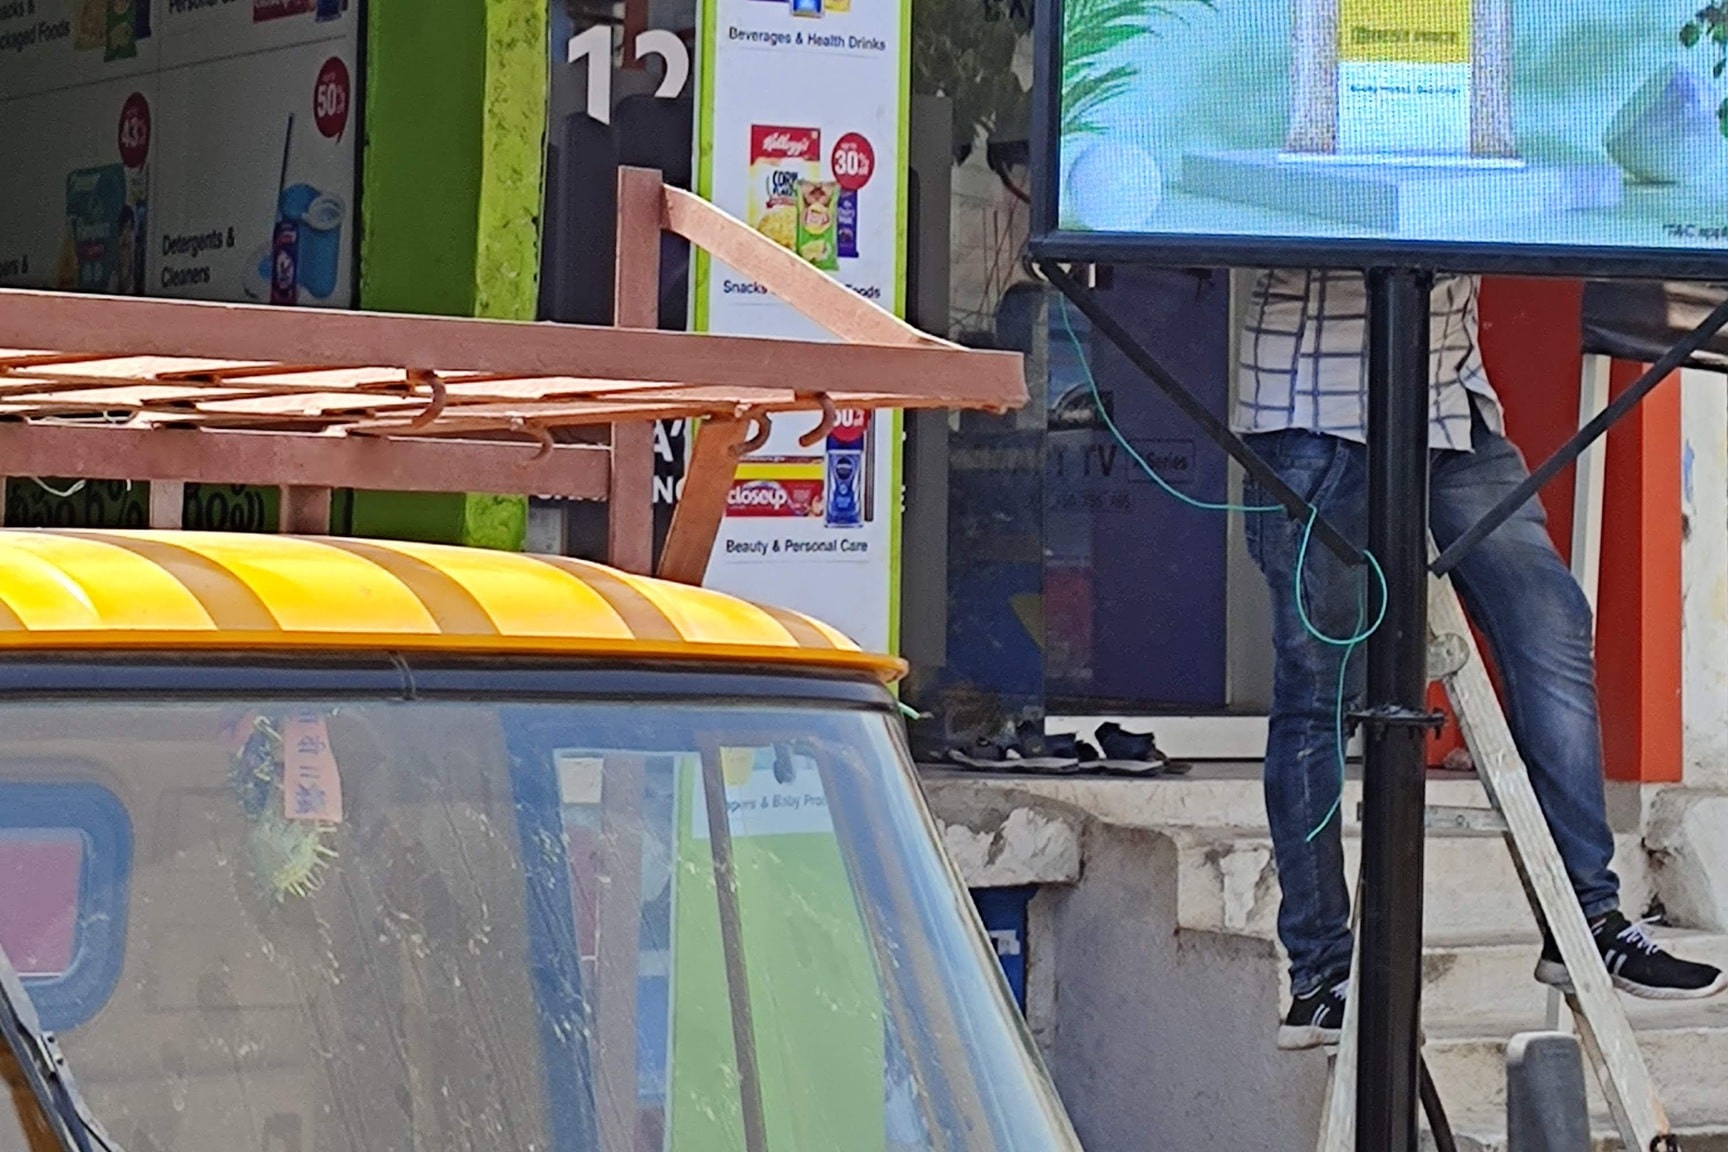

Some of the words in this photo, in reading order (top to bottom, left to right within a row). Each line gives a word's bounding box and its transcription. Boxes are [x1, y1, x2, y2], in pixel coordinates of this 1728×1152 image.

[729, 26, 791, 46] Beverages
[795, 32, 804, 46] &
[808, 32, 846, 49] Health
[848, 36, 886, 51] Drinks
[162, 230, 225, 258] Detergents
[161, 263, 210, 288] Cleaners
[727, 485, 788, 510] closeup
[726, 539, 768, 556] Beauty
[772, 539, 780, 553] &
[785, 539, 837, 553] Personal
[840, 539, 869, 553] Care
